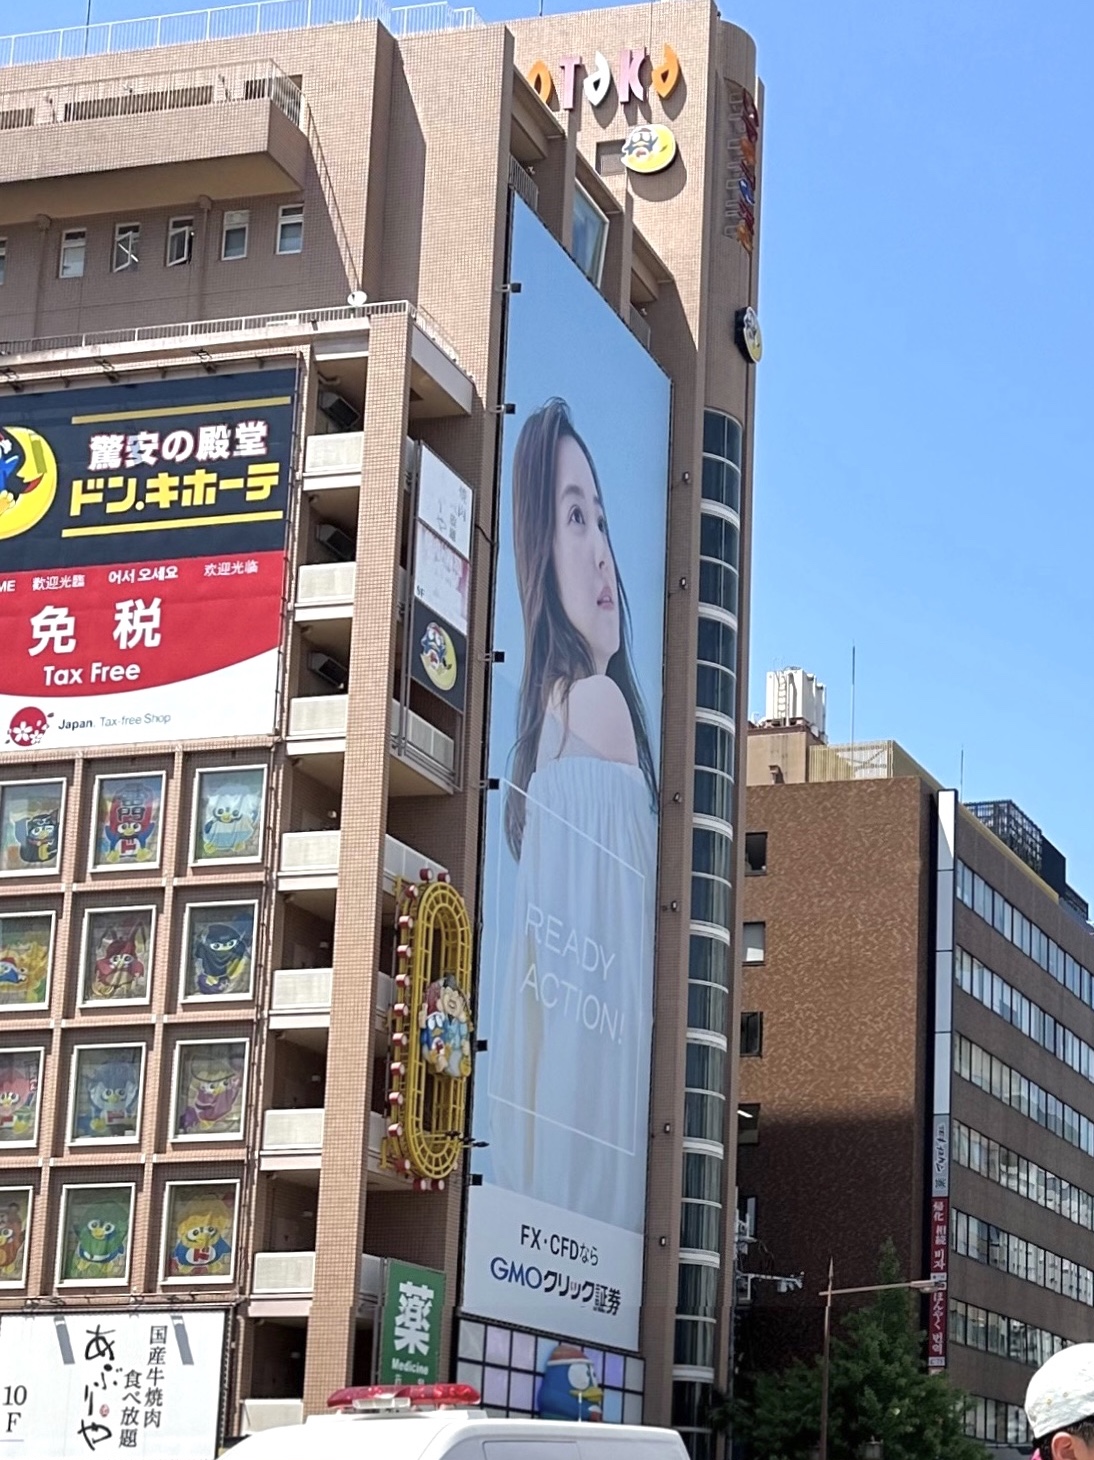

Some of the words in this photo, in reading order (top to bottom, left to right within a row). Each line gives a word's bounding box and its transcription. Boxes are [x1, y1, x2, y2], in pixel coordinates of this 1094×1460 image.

[88, 420, 268, 471] 驚安の殿堂
[108, 569, 135, 584] 어서
[138, 566, 178, 582] 오세요
[204, 560, 258, 577] 欢迎光临
[43, 665, 83, 686] Tax
[90, 662, 141, 683] Free
[100, 714, 142, 728] Tax-free
[144, 713, 171, 727] Shop
[525, 902, 615, 981] READY
[520, 963, 625, 1045] ACTION!
[490, 1256, 622, 1316] GMOクリック証券
[394, 1281, 434, 1356] 薬
[78, 1324, 123, 1451] あぶりや
[143, 1325, 168, 1429] 国産牛焼肉
[391, 1357, 429, 1376] Medicine
[3, 1385, 28, 1406] 10
[118, 1369, 143, 1449] 食べ放題
[6, 1412, 22, 1433] F
